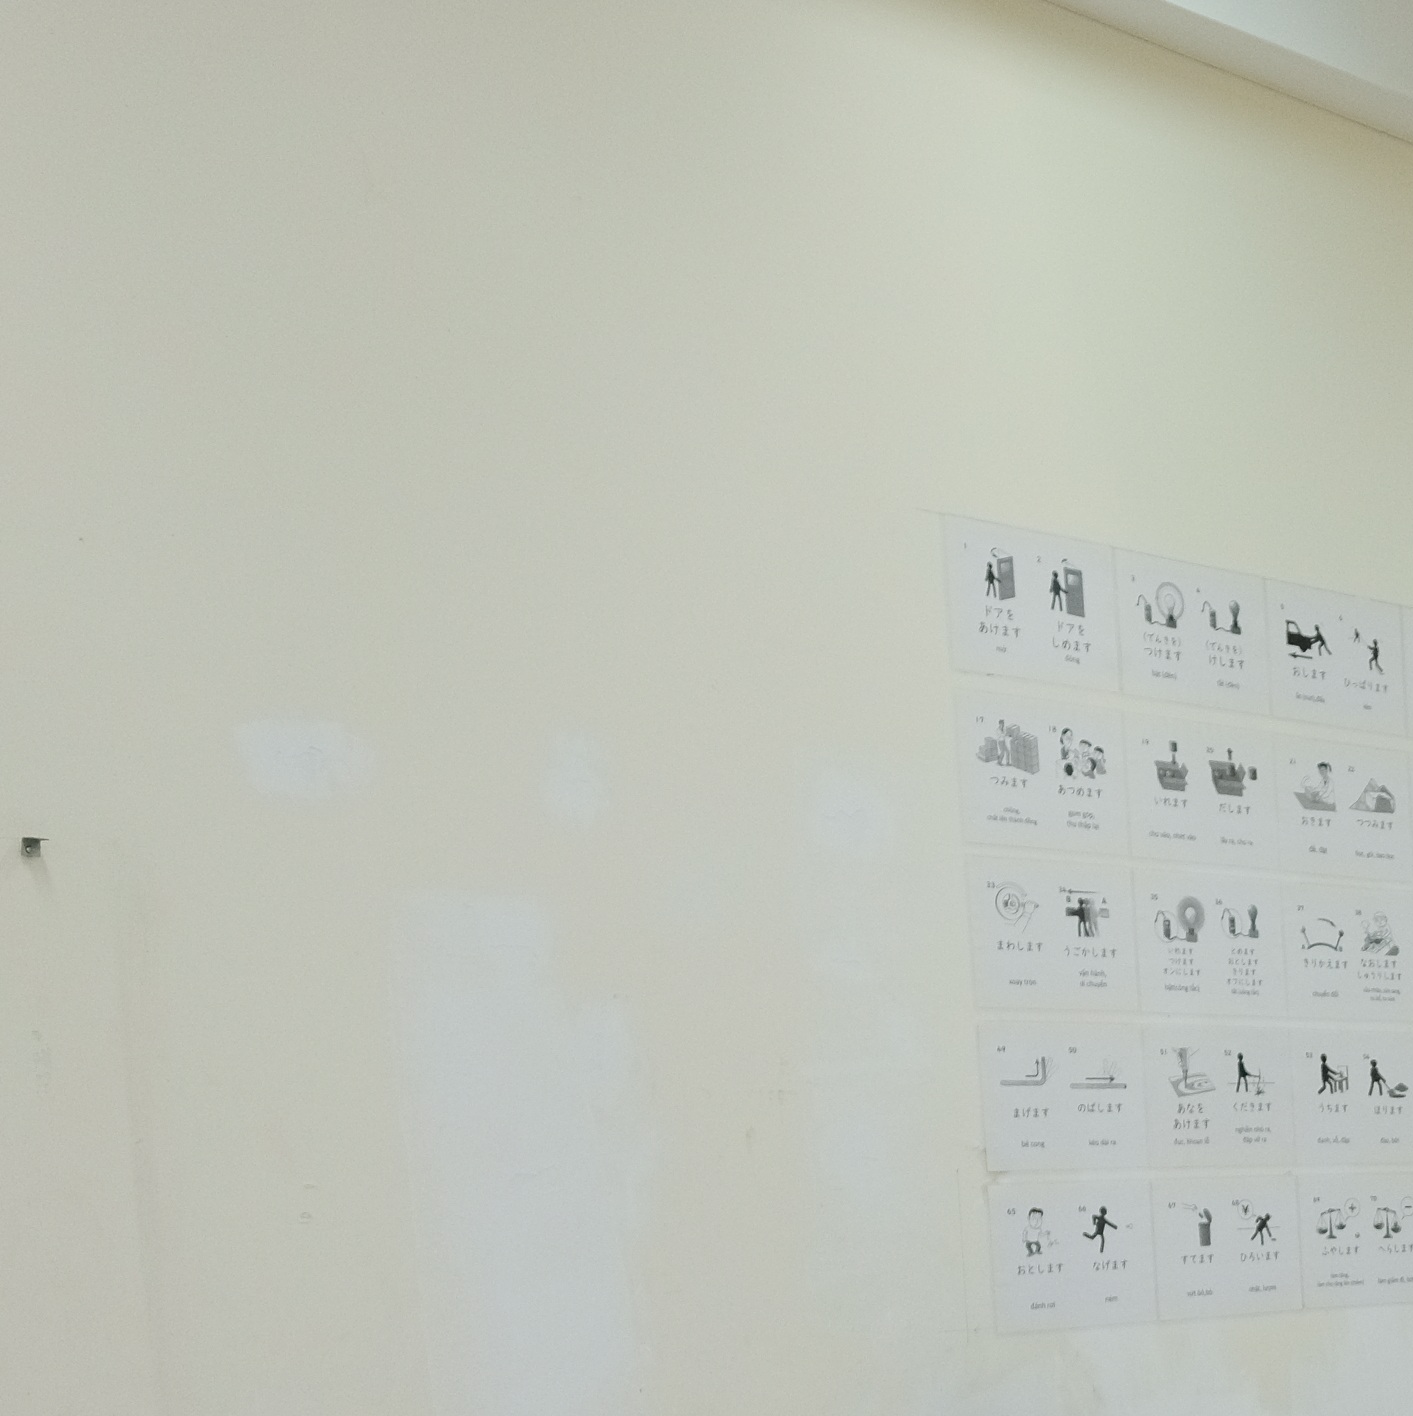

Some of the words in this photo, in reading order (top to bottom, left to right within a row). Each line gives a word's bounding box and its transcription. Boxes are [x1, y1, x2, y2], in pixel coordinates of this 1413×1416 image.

[986, 605, 1013, 620] ドアを
[979, 622, 1020, 638] あけます
[1058, 622, 1084, 636] ドアを
[1053, 634, 1091, 652] しめます
[1144, 644, 1182, 661] つけます
[991, 776, 1027, 788] つみます
[1058, 785, 1102, 798] あつめます
[997, 941, 1042, 951] まわします
[1064, 946, 1116, 958] うごかします
[1014, 1107, 1048, 1118] まげます
[1078, 1103, 1122, 1113] のばします
[1178, 1103, 1203, 1114] あなを
[1174, 1118, 1209, 1129] あけます
[1379, 1244, 1413, 1254] へらします
[1181, 1254, 1214, 1264] すてます
[1240, 1251, 1279, 1262] ひろいます
[1018, 1263, 1063, 1275] おとします
[1093, 1260, 1127, 1271] なげます
